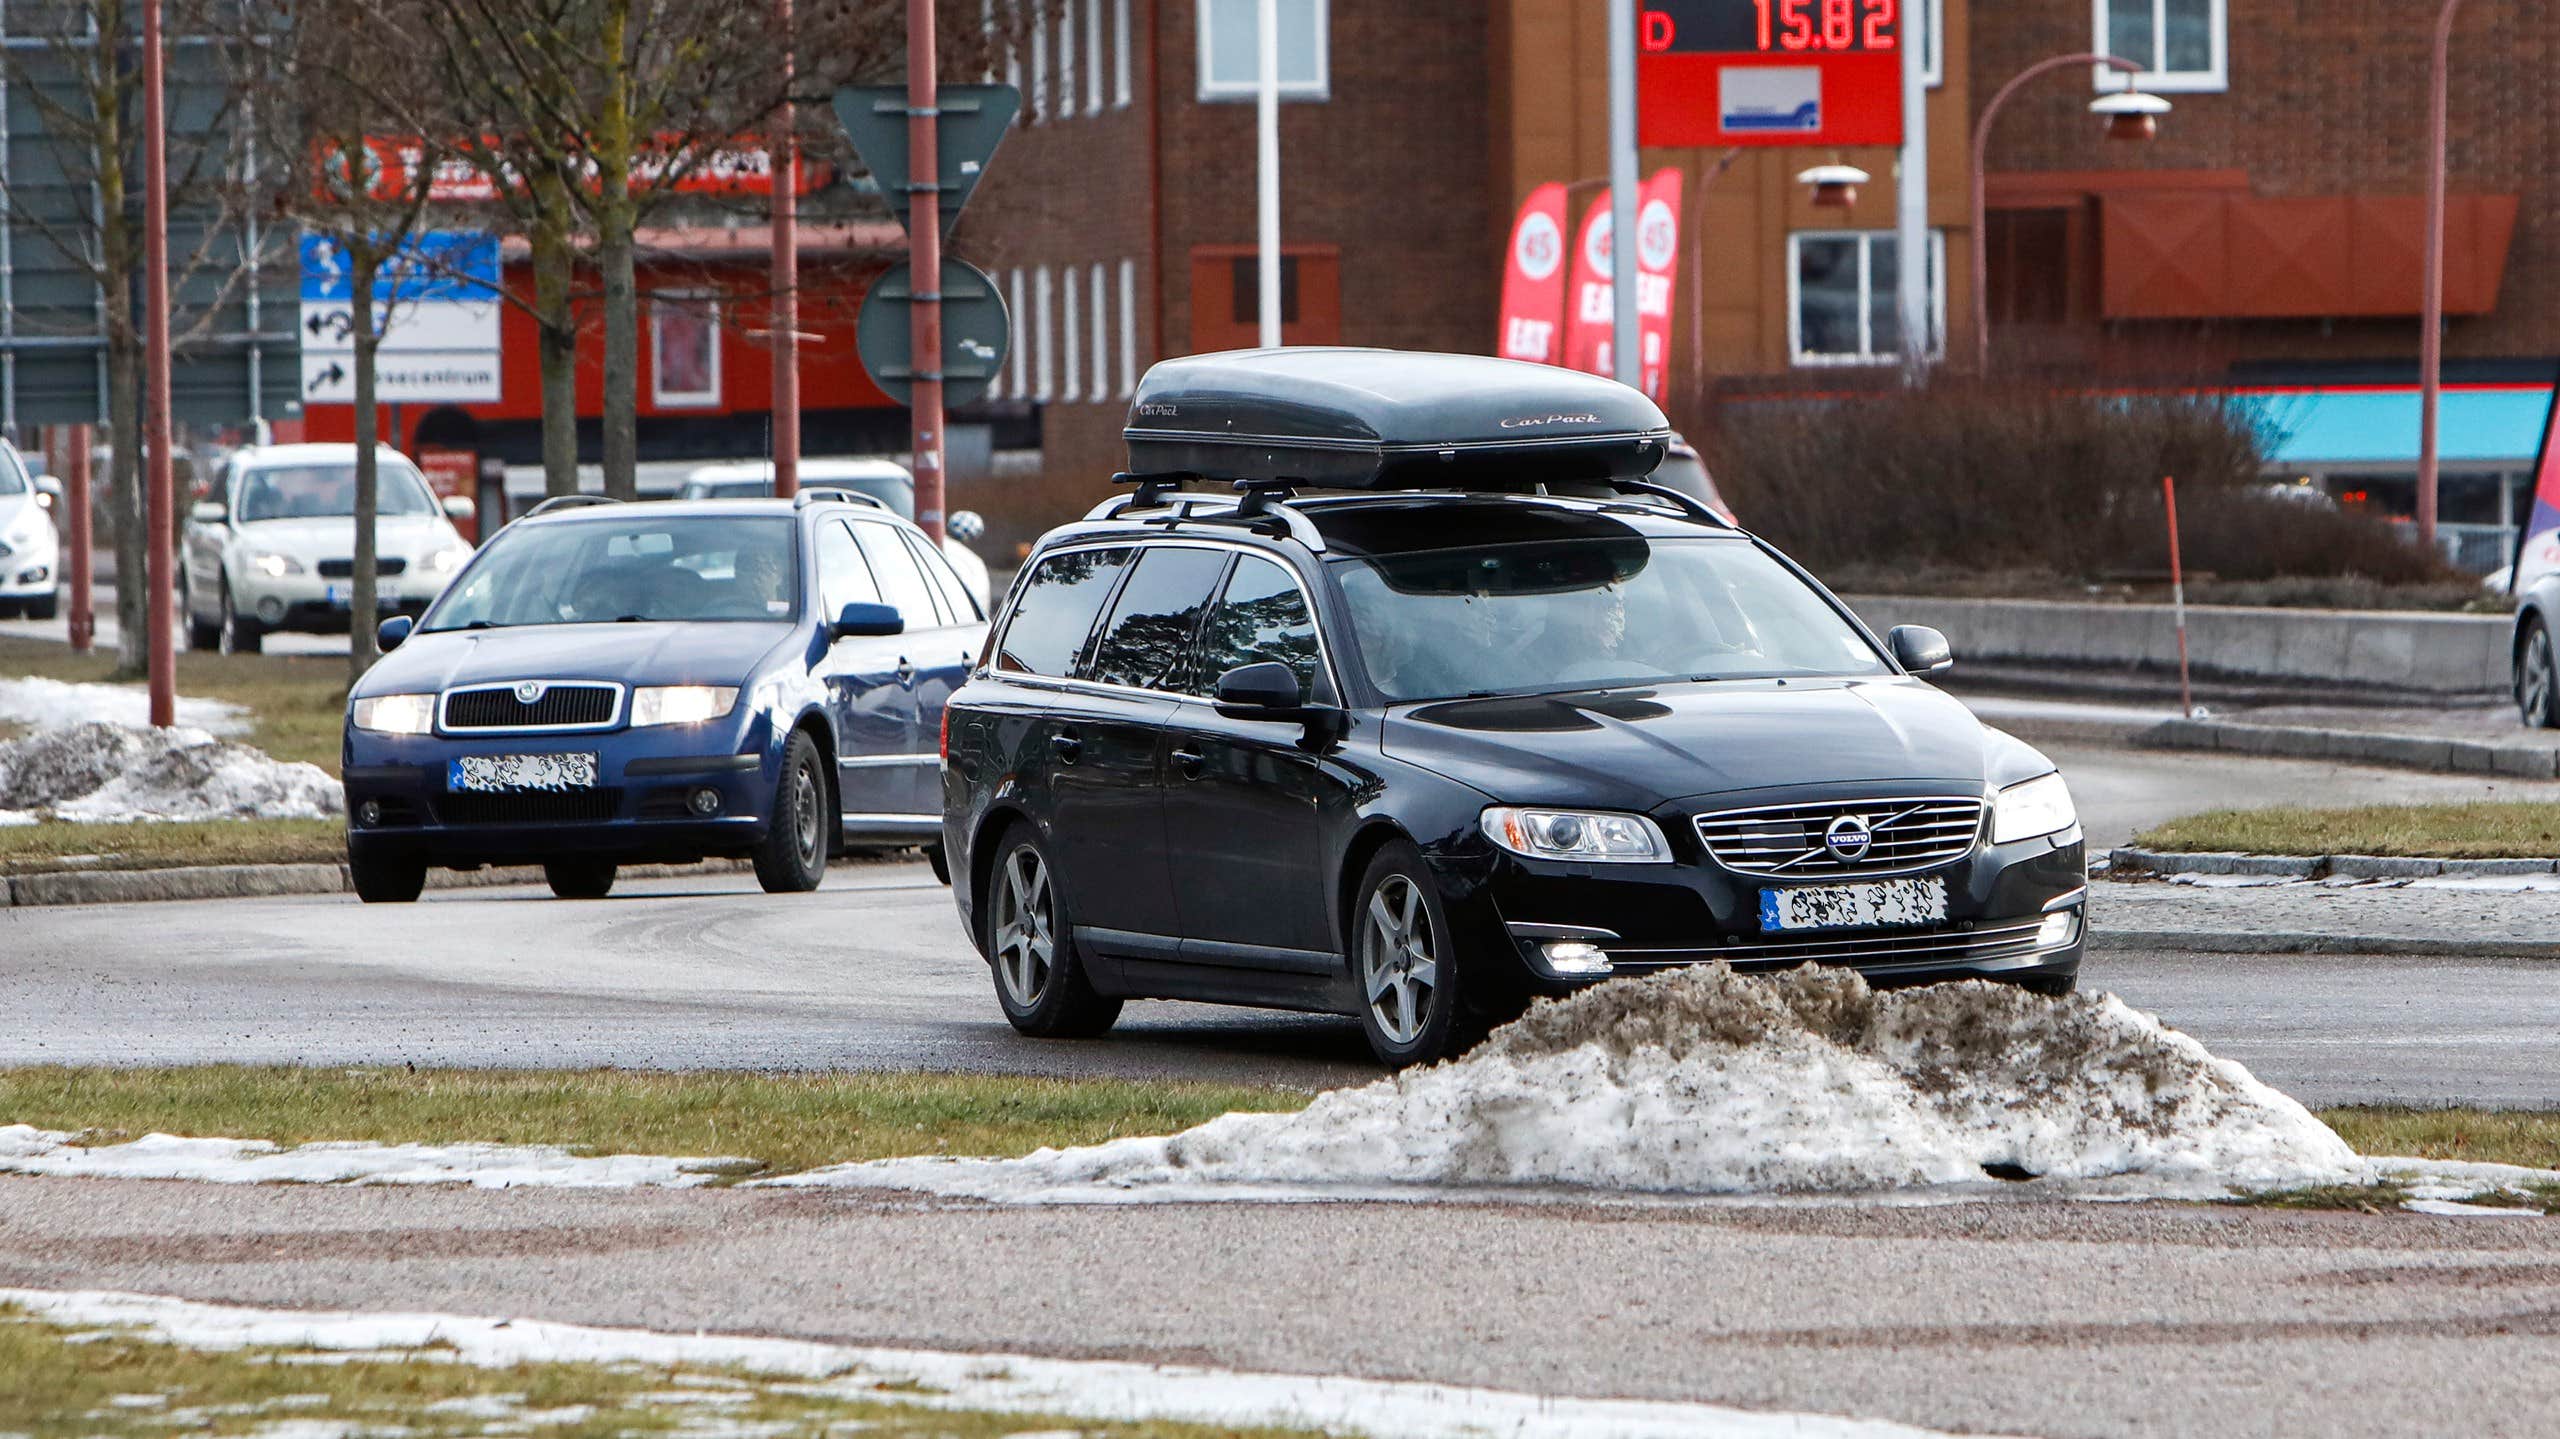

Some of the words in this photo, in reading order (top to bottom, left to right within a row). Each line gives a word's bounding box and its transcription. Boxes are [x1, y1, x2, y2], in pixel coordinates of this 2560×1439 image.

[1641, 10, 1676, 50] D
[1753, 0, 1896, 50] 15.82
[1506, 316, 1554, 362] EAT
[1829, 834, 1868, 843] VOLVO
